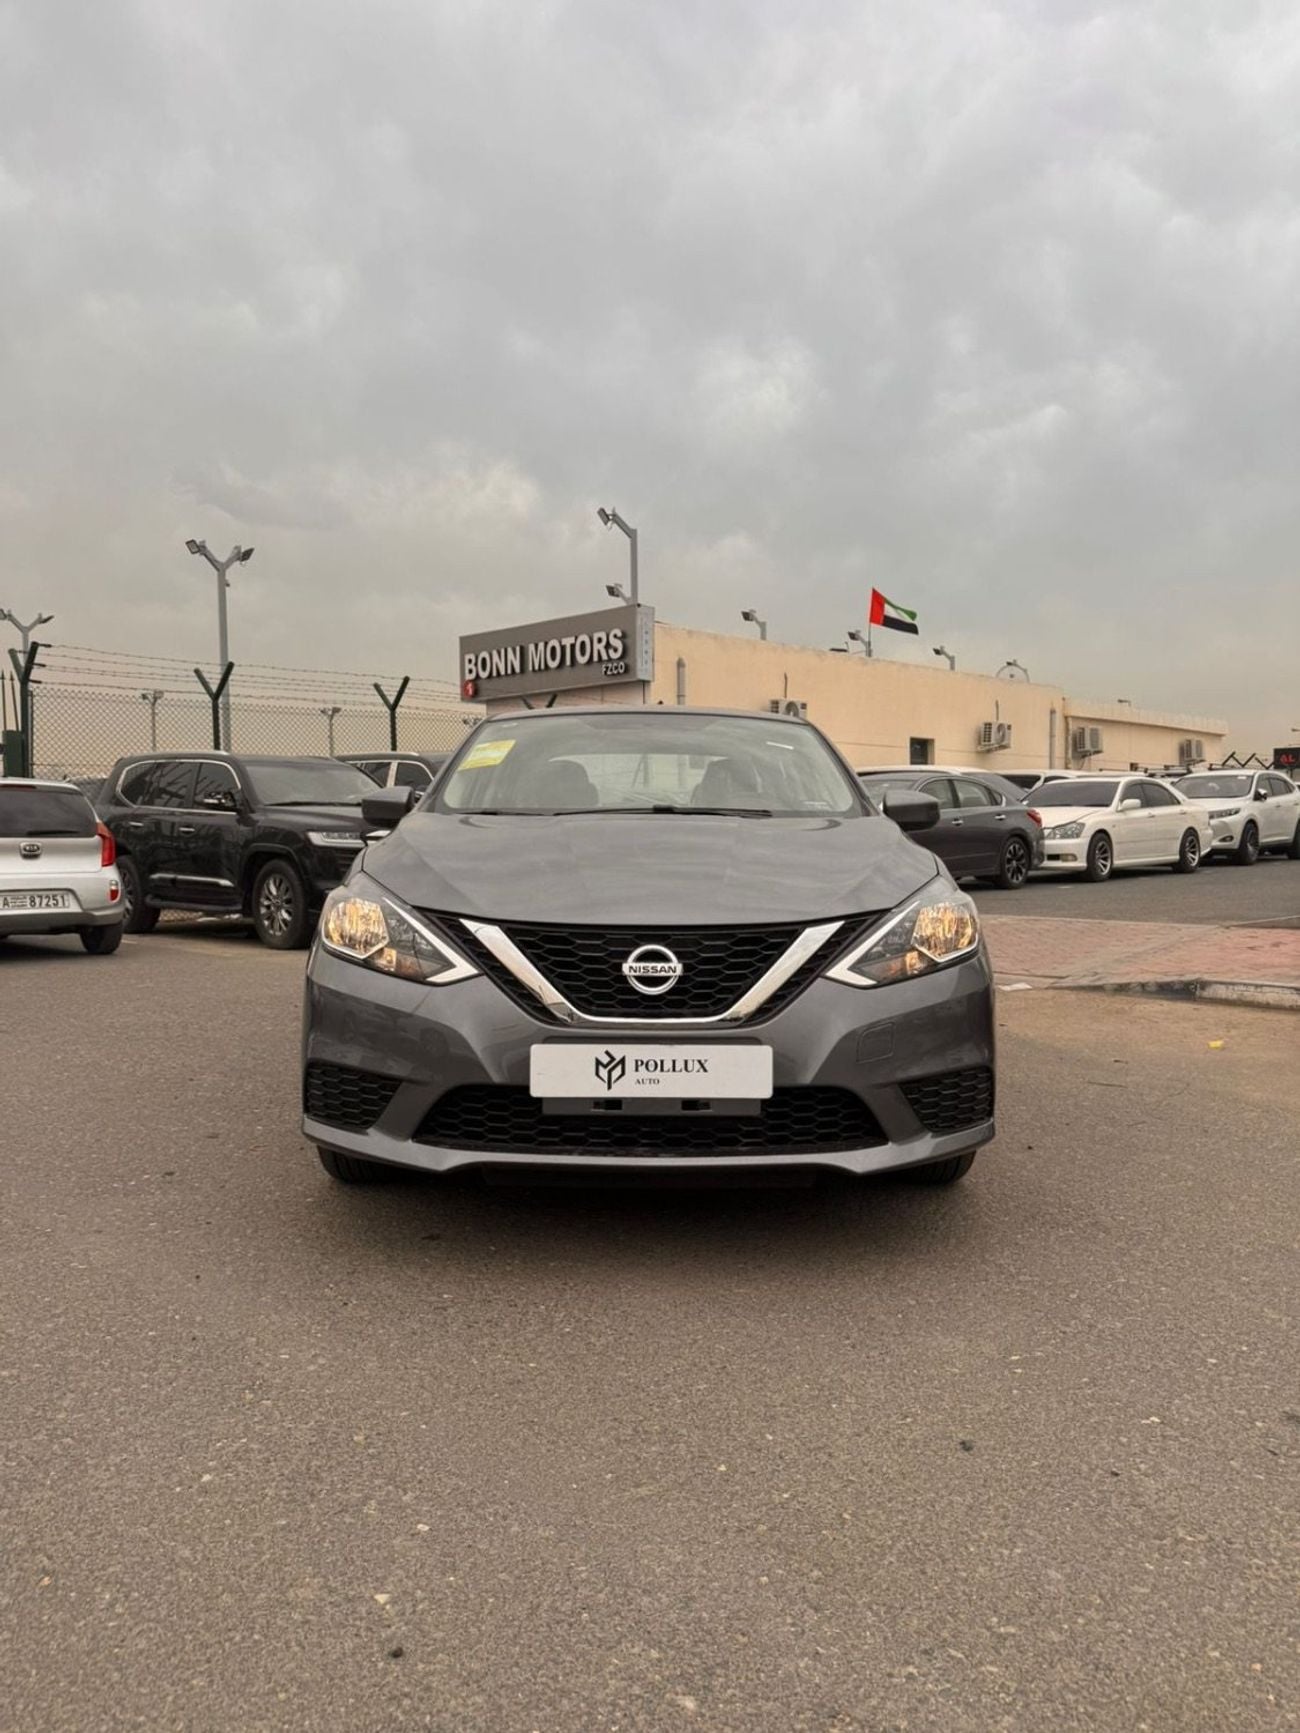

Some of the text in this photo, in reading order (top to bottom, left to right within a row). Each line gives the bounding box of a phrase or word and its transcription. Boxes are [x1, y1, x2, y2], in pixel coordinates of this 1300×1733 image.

[464, 645, 521, 680] BONN
[528, 627, 624, 671] MOTORS
[601, 661, 626, 675] FZCO
[29, 895, 66, 908] 87251
[628, 965, 678, 974] NISSAN
[634, 1058, 709, 1074] POLLUX
[635, 1078, 660, 1086] AUTO
